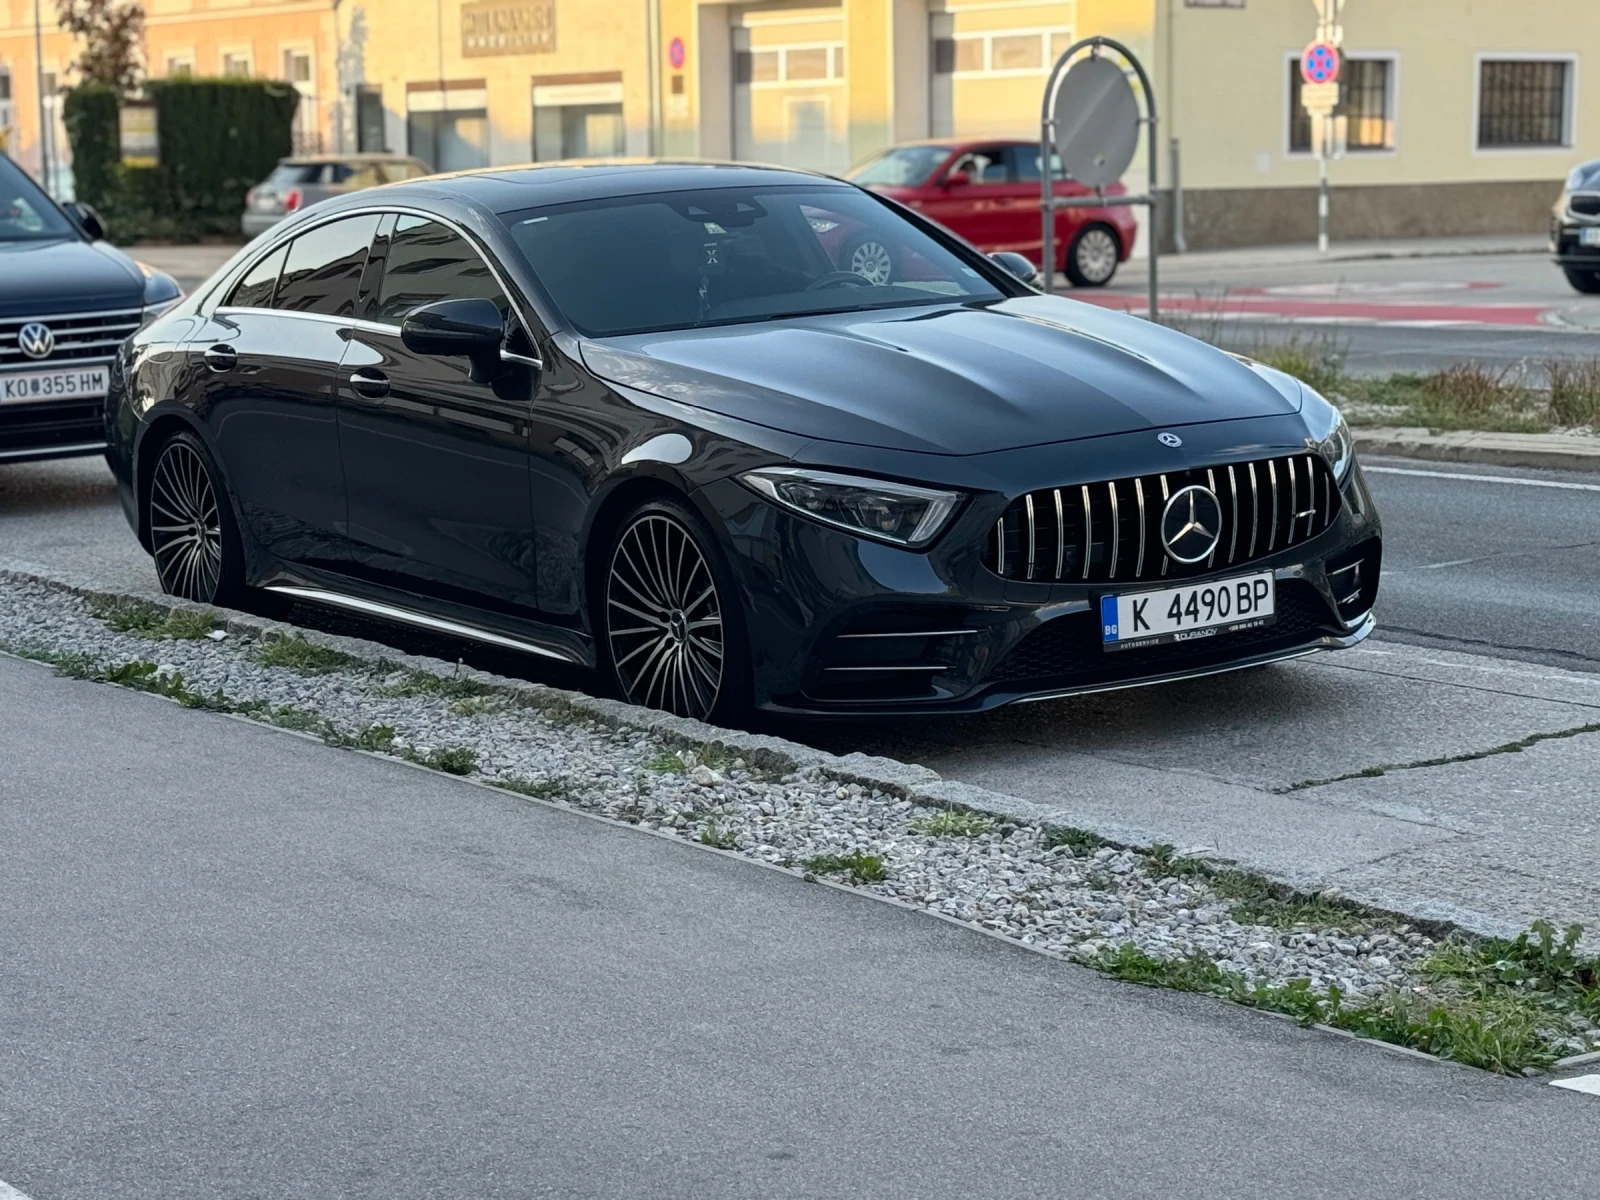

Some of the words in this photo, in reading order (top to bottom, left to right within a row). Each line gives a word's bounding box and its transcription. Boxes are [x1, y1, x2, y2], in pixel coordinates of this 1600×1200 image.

[20, 323, 53, 357] VW
[42, 375, 76, 395] 355
[80, 372, 104, 392] HM
[1133, 598, 1151, 632] K
[1167, 586, 1231, 626] 4490
[1236, 579, 1268, 615] BP
[1104, 625, 1118, 635] BG
[1120, 639, 1159, 649] AUTOSERVICE
